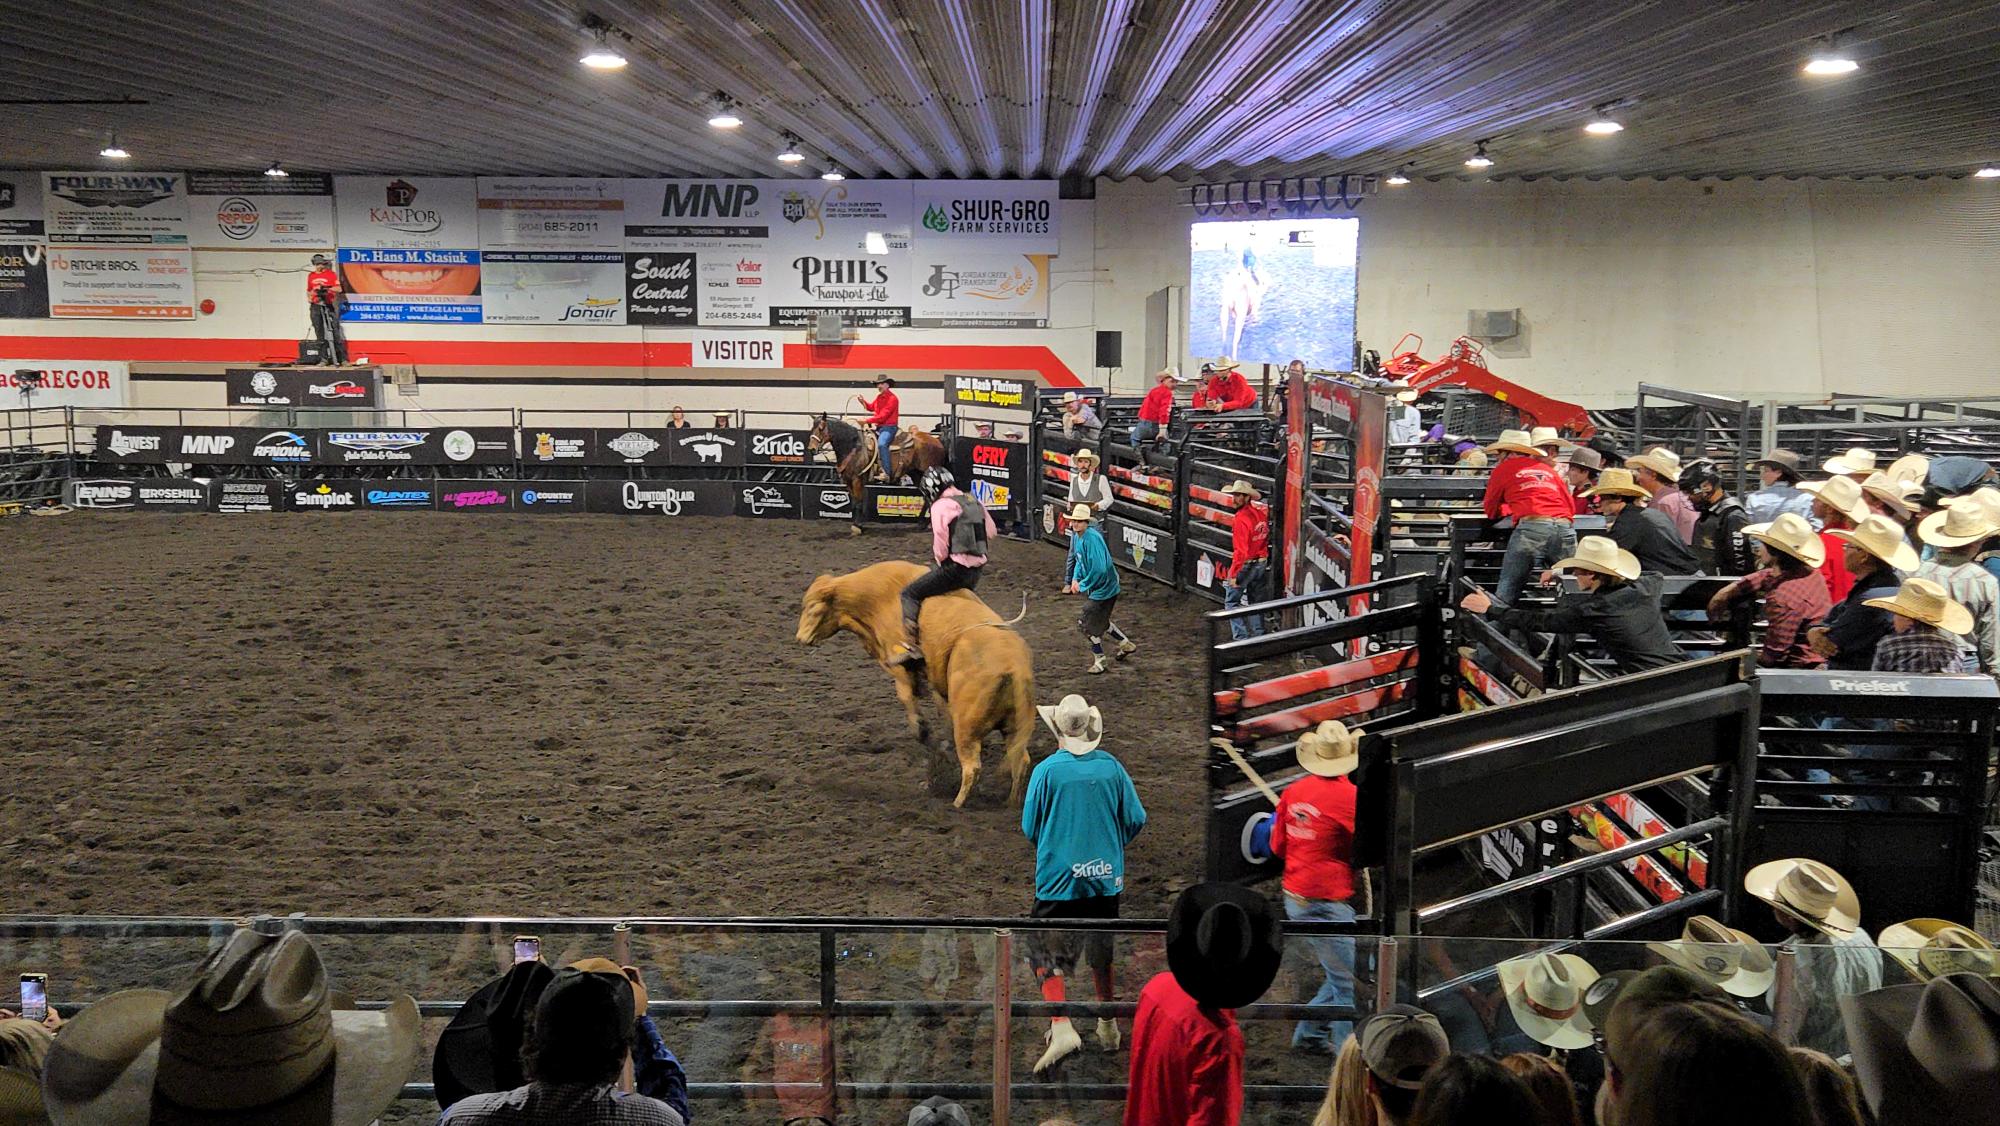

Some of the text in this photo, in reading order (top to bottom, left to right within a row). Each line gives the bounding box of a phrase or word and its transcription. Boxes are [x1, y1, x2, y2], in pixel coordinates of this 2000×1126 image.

[661, 183, 759, 218] MNP
[744, 210, 760, 218] LLP
[951, 199, 1050, 221] SHUR-GRO
[544, 222, 599, 232] 685-2011
[952, 221, 1049, 234] FARM SERVICES
[351, 251, 468, 263] Dr. Hans M. Stasiuk
[70, 260, 141, 271] RITCHIE BROS.
[631, 256, 692, 280] South
[632, 282, 689, 300] Central
[812, 285, 864, 302] Transport
[702, 340, 773, 361] VISITOR
[991, 379, 1023, 393] Thrives
[240, 396, 291, 404] Lions Club
[957, 389, 1022, 406] with Your Support!
[329, 431, 427, 442] FOUR-WAY
[752, 432, 805, 456] Stride
[181, 435, 235, 455] MNP
[972, 444, 1009, 467] CFRY
[150, 488, 203, 499] ROSEHILL
[295, 491, 356, 509] Simplot
[368, 490, 432, 504] QUINTEX
[536, 492, 574, 500] COUNTRY
[823, 494, 848, 502] CO-OP
[1123, 526, 1158, 553] PORTAGE
[1828, 679, 1911, 692] Priefert
[1072, 858, 1113, 879] Stride
